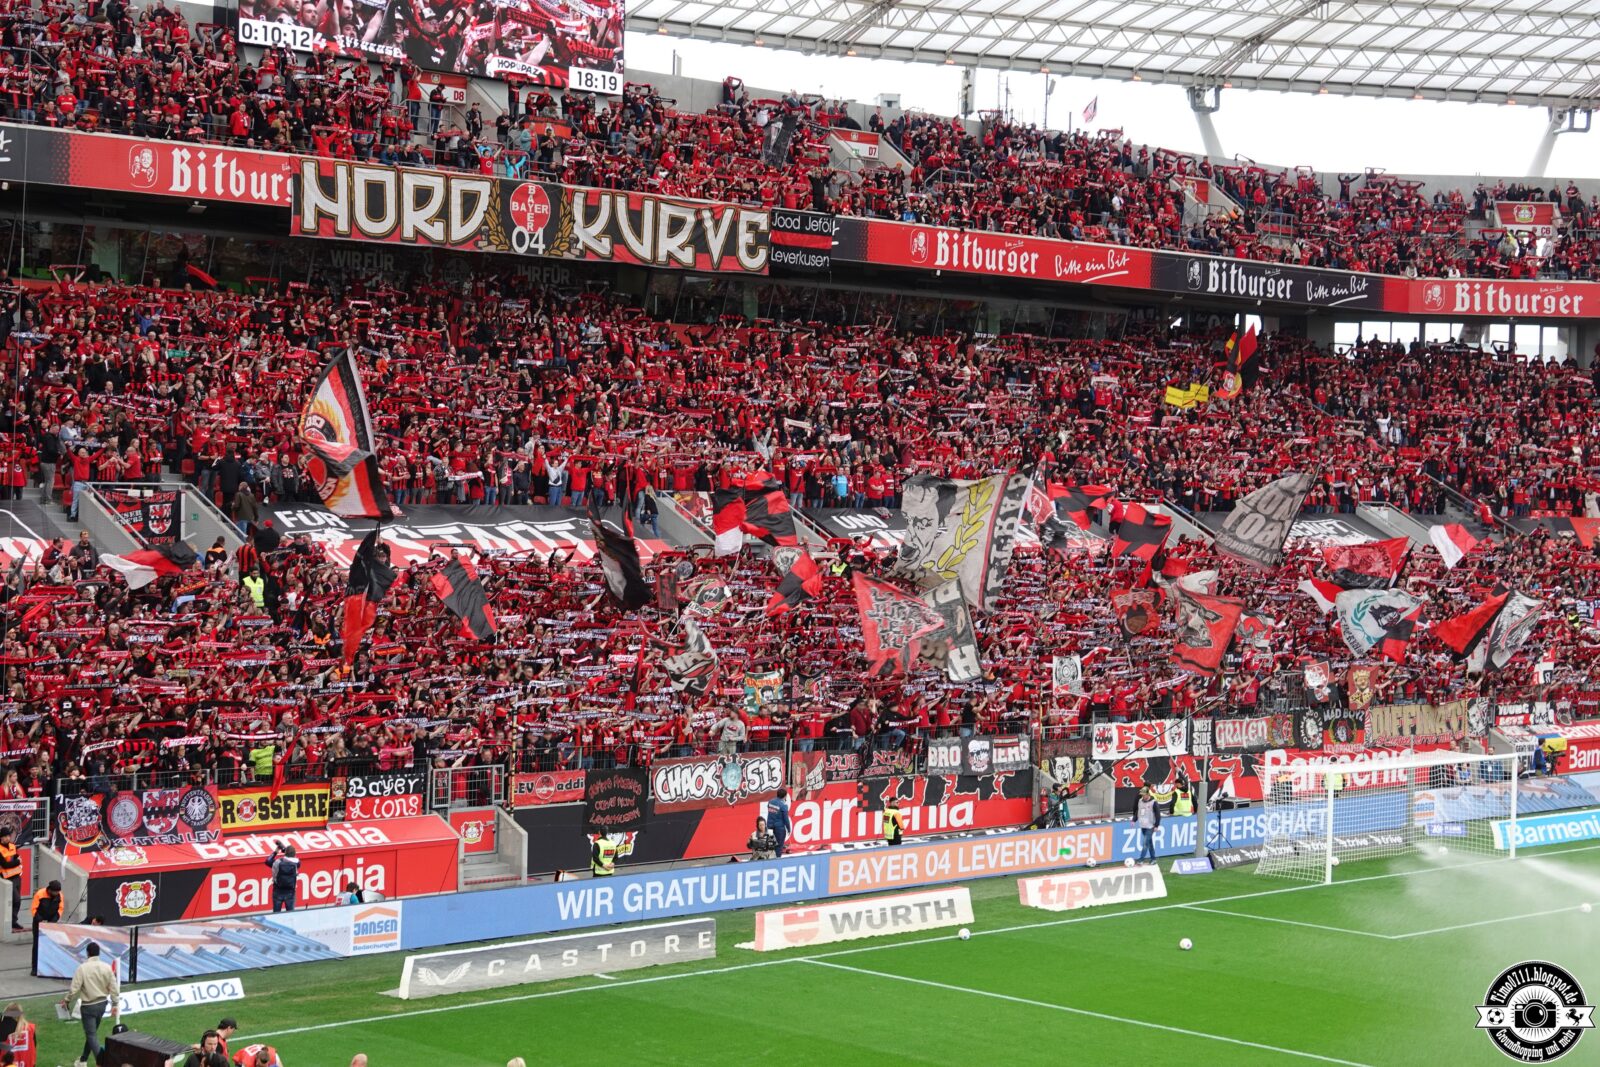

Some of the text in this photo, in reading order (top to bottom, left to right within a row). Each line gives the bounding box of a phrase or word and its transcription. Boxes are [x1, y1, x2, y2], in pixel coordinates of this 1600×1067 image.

[241, 22, 310, 48] 0:10:12
[577, 71, 617, 91] 18:19
[302, 160, 493, 243] NORD
[511, 201, 549, 216] BAYER
[573, 191, 768, 270] KURVE
[771, 212, 801, 230] Jood
[511, 226, 546, 254] 04
[934, 230, 1040, 275] Bitburger
[770, 246, 830, 267] Leverkusen
[1055, 249, 1130, 277] Bitte ein Bit
[1207, 260, 1294, 300] Bitburger
[1306, 276, 1369, 301] Bitte ein Bit
[1454, 282, 1584, 315] Bitburger
[274, 509, 350, 529] FÜR
[832, 513, 889, 530] UND
[347, 776, 420, 798] Bayer
[514, 782, 535, 794] EV
[655, 761, 720, 803] CHAOS
[746, 757, 783, 792] 513
[186, 829, 221, 843] LEV
[1506, 813, 1600, 846] Barmeni
[838, 832, 1106, 888] BAYER 04 LEVERKUSEN
[557, 864, 816, 921] WIR GRATULIEREN
[1038, 870, 1155, 909] tipwin
[353, 919, 398, 936] JANSEN
[829, 898, 957, 935] WÜRTH
[487, 930, 713, 978] CASTORE
